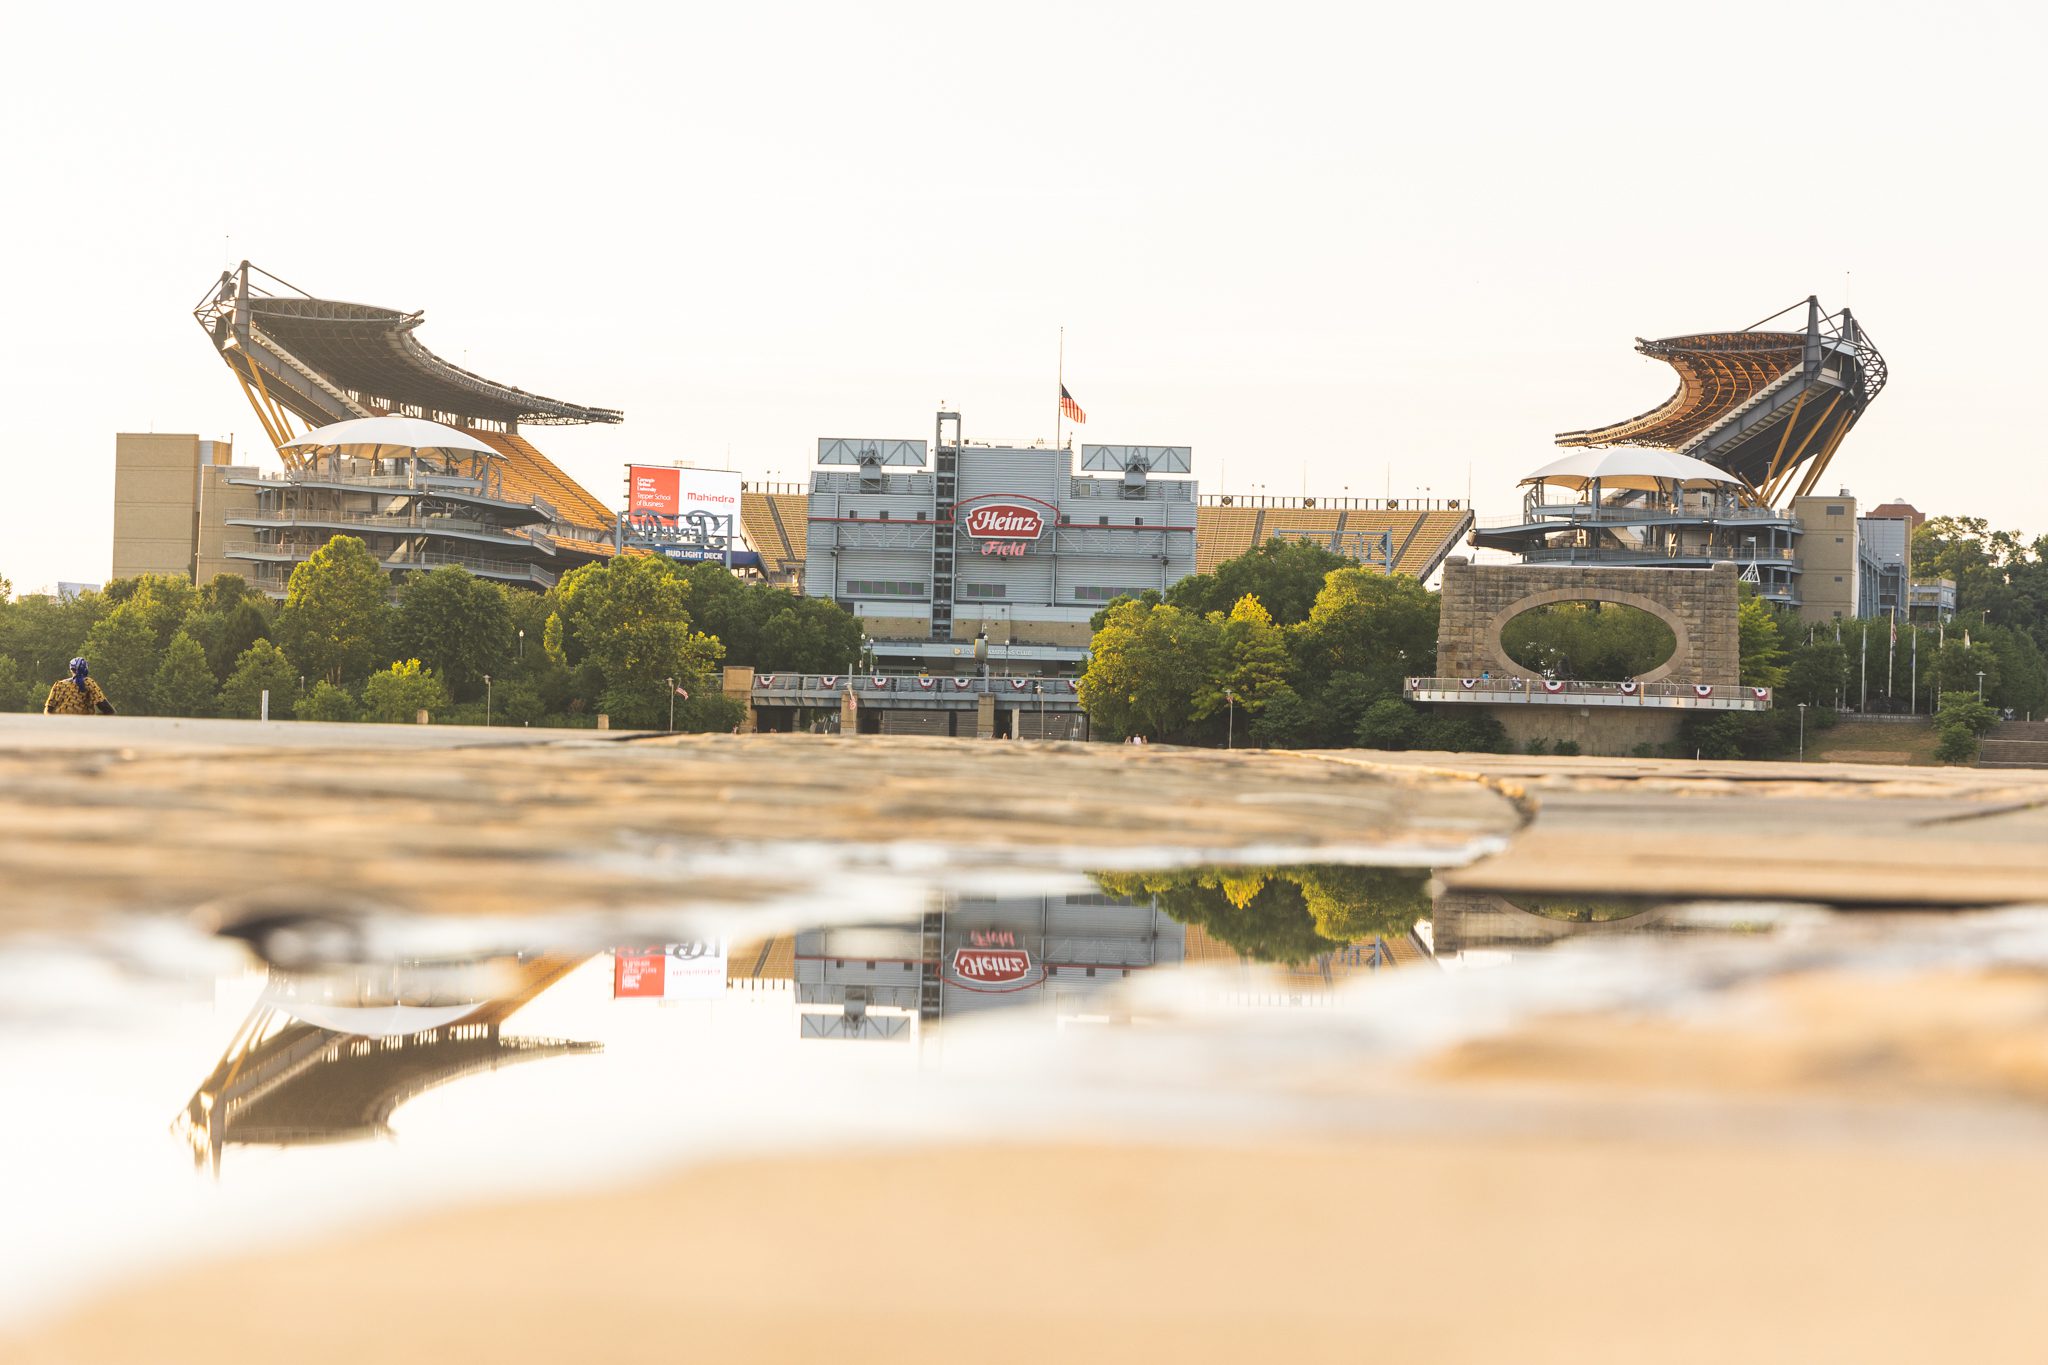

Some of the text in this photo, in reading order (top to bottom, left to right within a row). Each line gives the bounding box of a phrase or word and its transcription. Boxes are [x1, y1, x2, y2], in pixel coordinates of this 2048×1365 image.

[637, 492, 671, 501] Tepper School
[687, 492, 735, 504] Mahindra
[642, 499, 664, 507] Business
[972, 510, 1037, 531] Heinz
[981, 540, 1027, 557] Field
[681, 551, 703, 559] LIGHT
[703, 552, 723, 560] DECK
